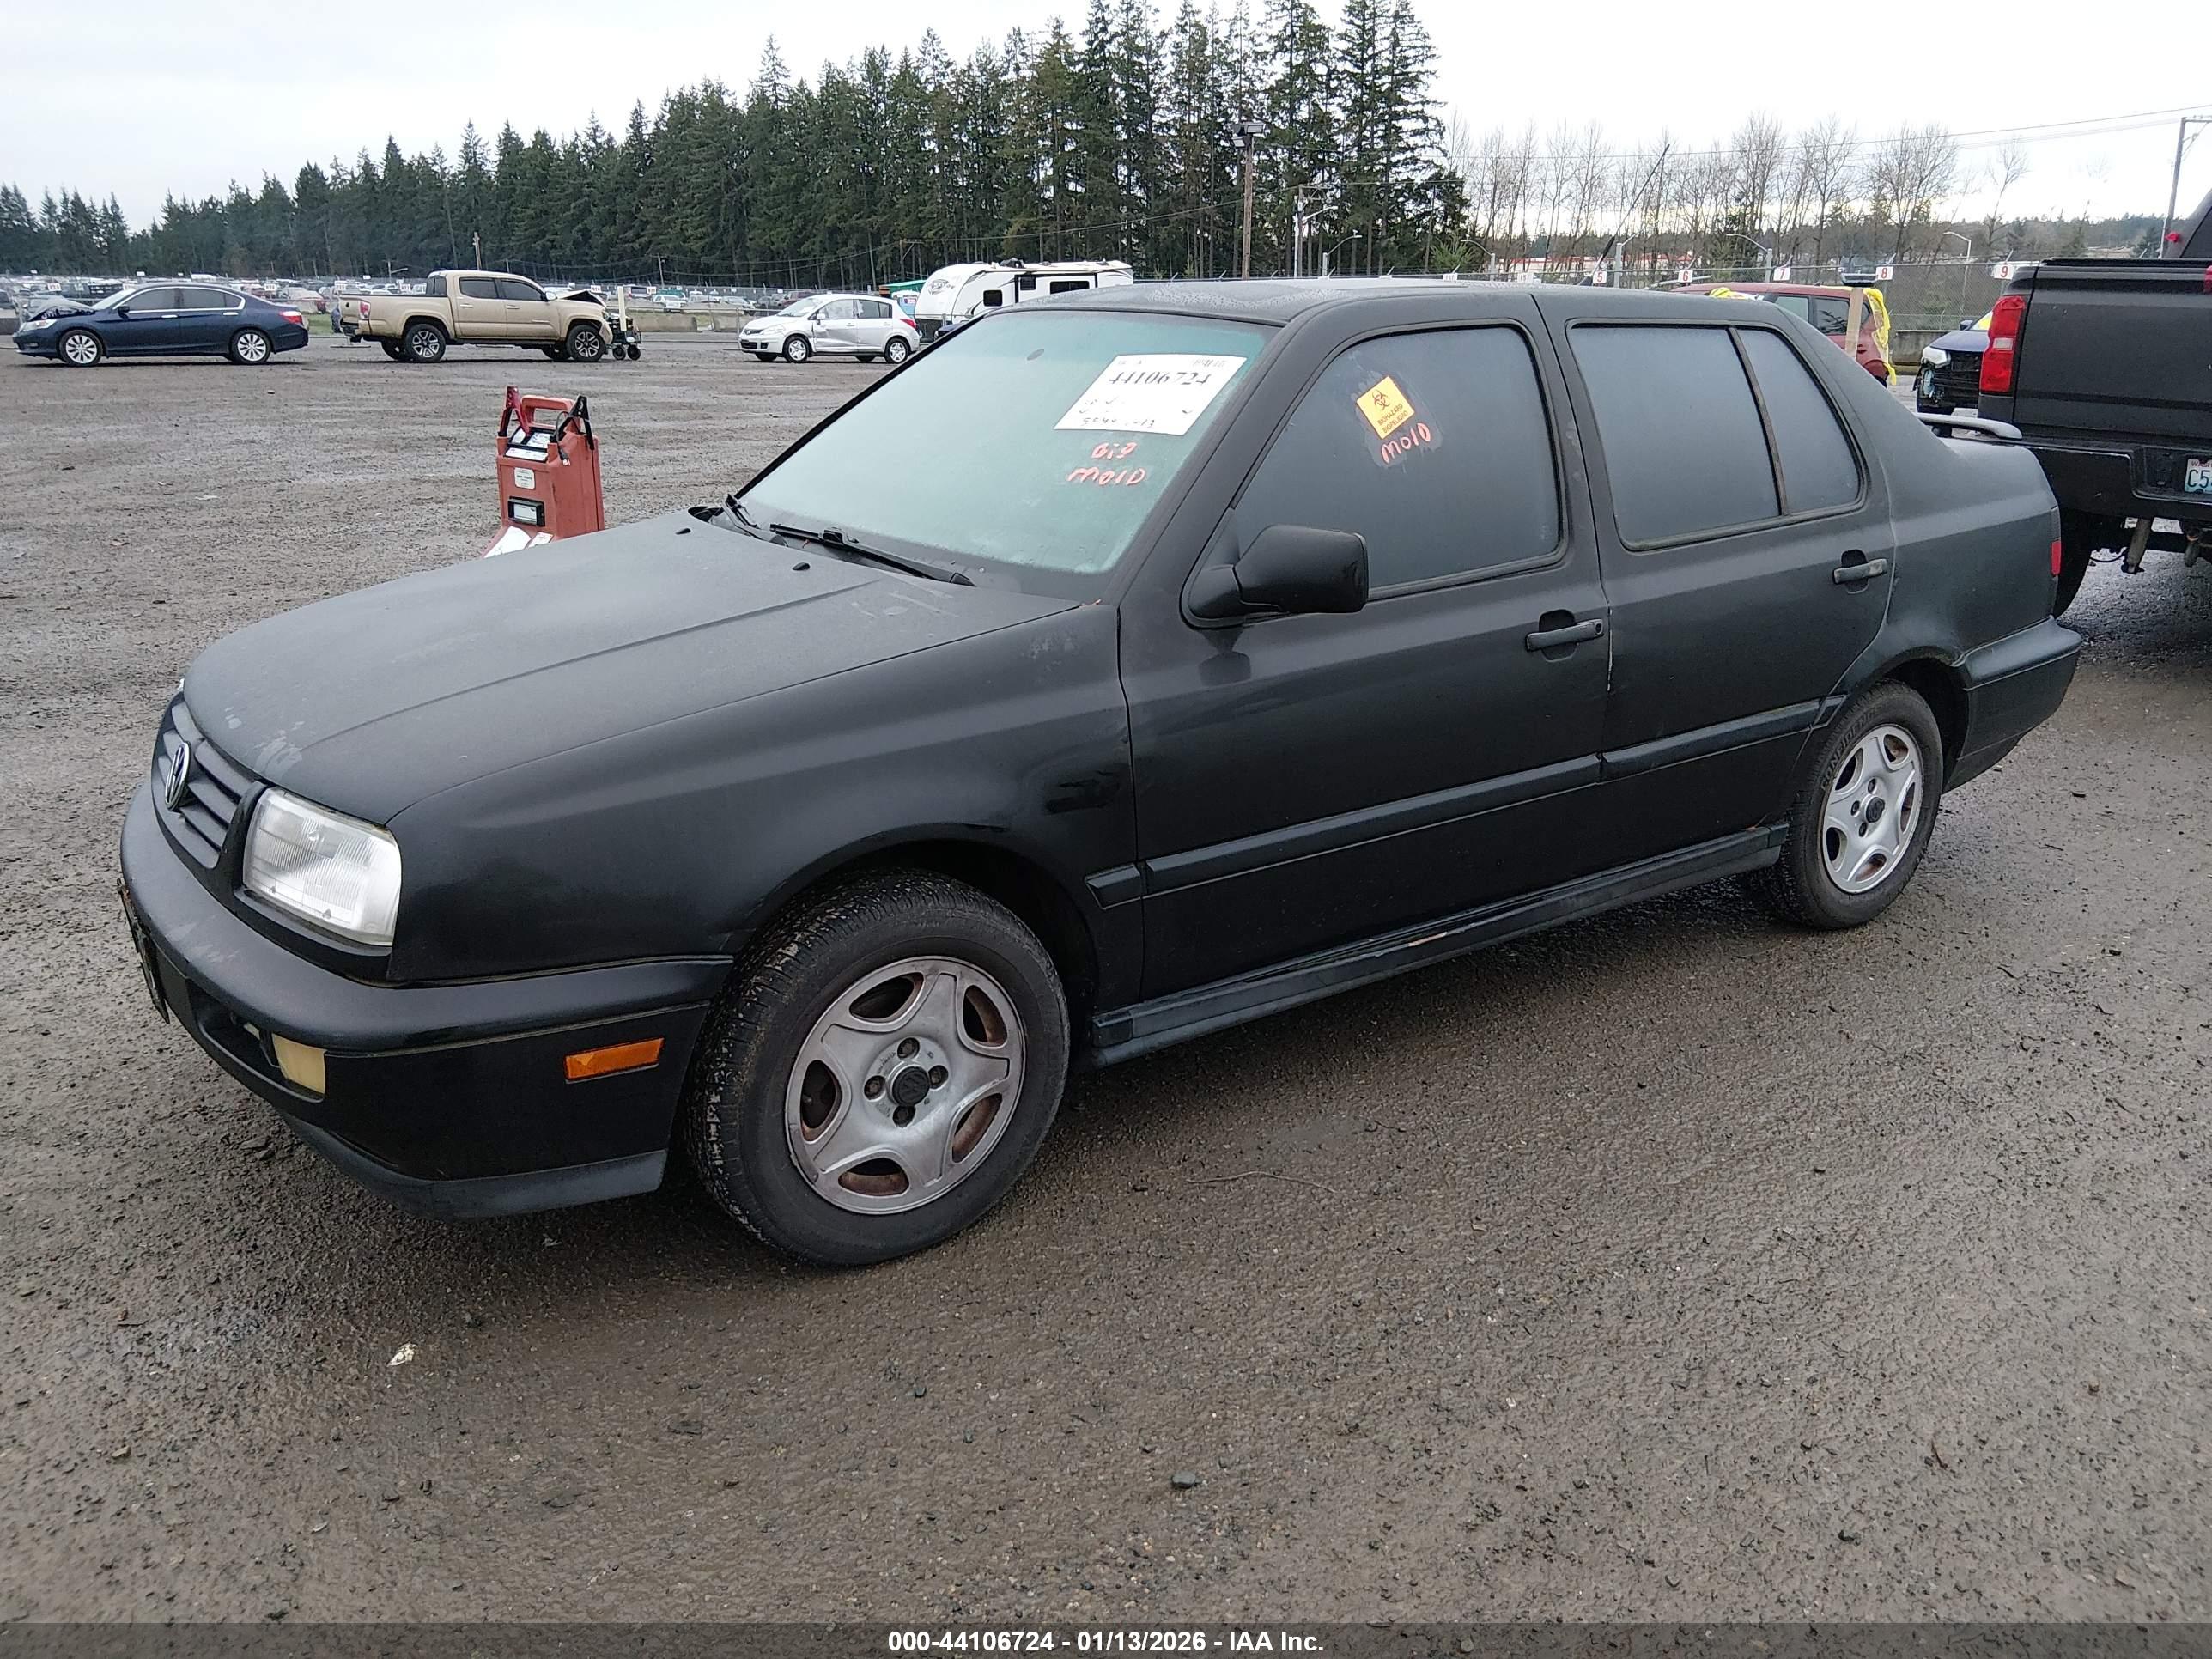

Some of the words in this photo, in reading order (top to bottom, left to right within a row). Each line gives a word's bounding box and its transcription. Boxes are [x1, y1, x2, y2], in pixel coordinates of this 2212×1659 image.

[1683, 270, 1689, 281] 6
[1780, 269, 1786, 279] 7
[1881, 267, 1888, 279] 8
[2000, 265, 2009, 278] 9
[1109, 371, 1212, 386] 44106724
[1377, 403, 1403, 426] BIOHAZARD
[2187, 469, 2212, 489] C5
